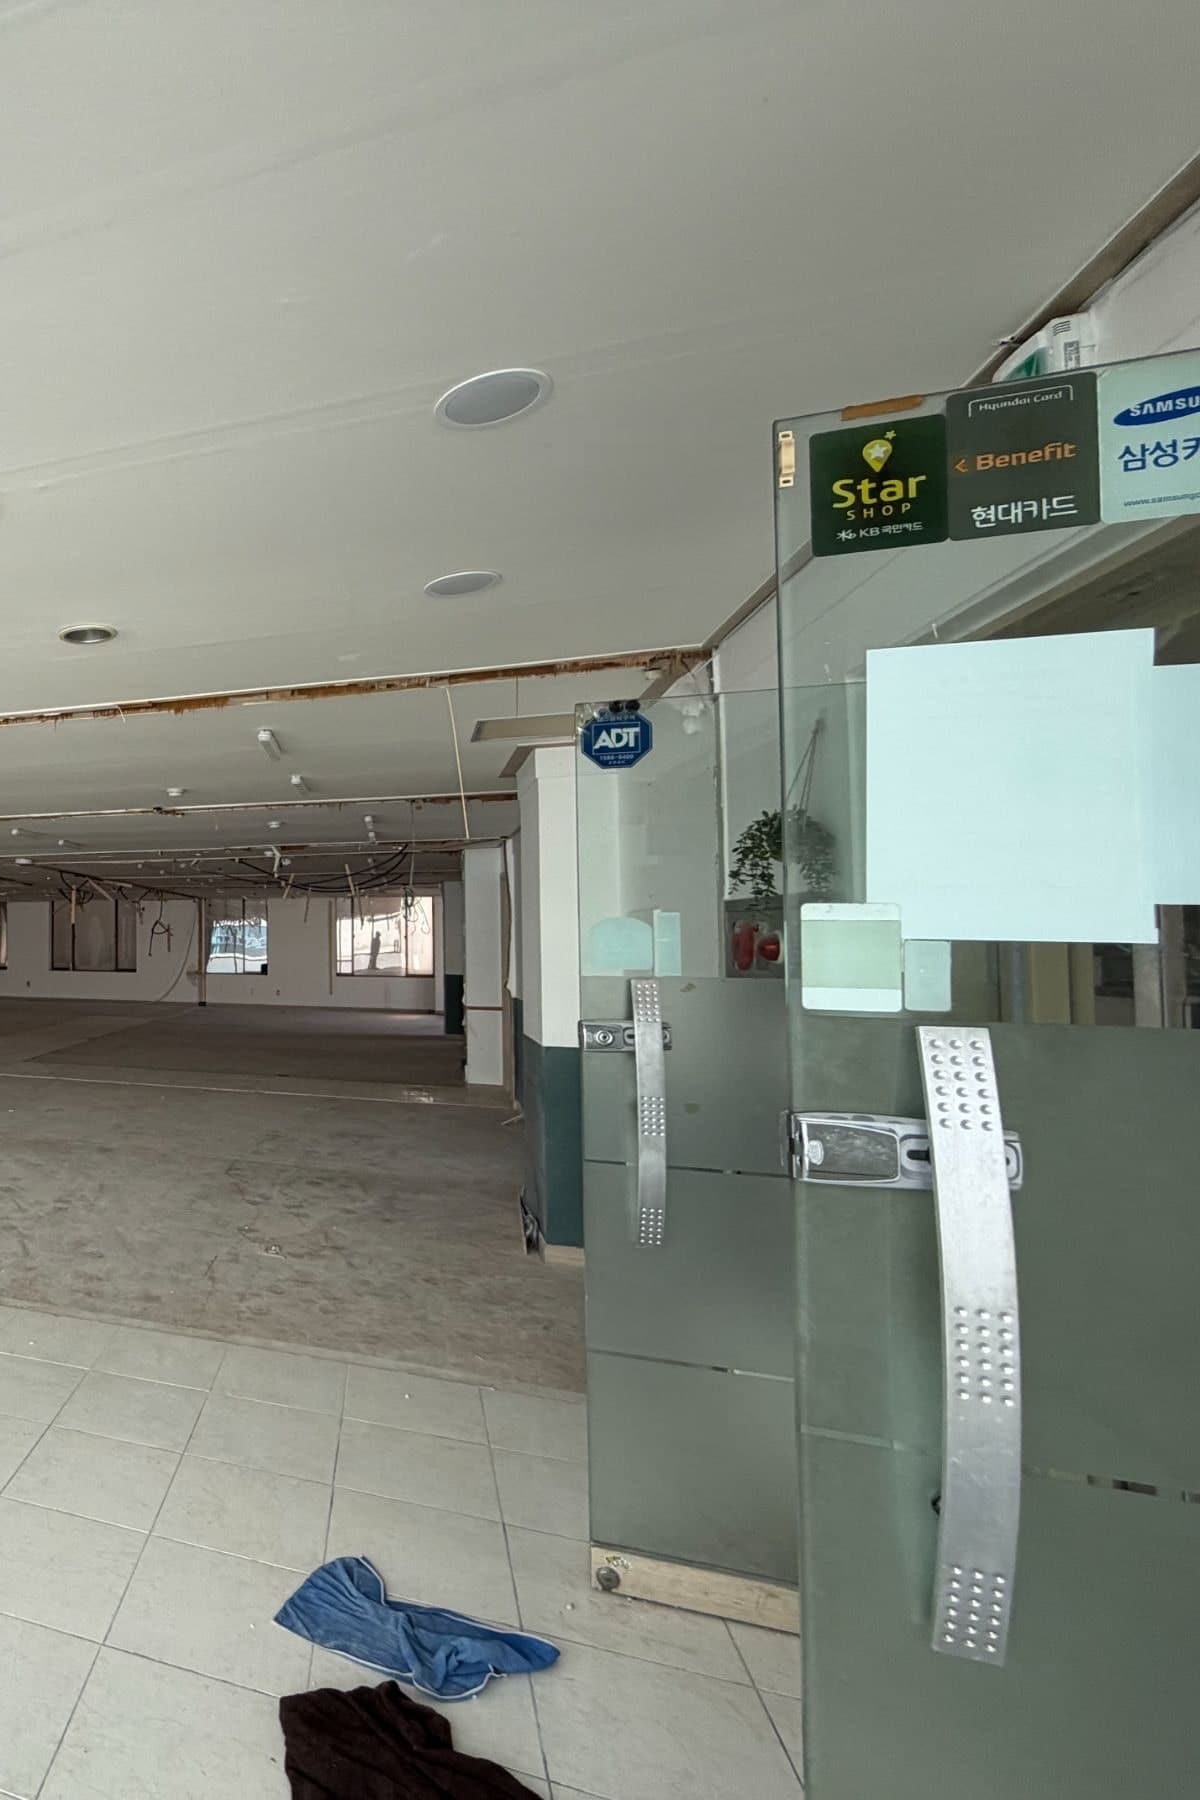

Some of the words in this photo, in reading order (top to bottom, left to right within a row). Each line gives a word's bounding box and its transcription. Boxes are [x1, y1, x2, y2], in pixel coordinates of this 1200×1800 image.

[979, 397, 1030, 411] Hyundai
[1033, 391, 1063, 403] Card
[976, 442, 1077, 471] Benefit
[832, 475, 927, 508] Star
[846, 502, 911, 520] SHOP
[970, 495, 1079, 528] 현대카드
[592, 727, 640, 749] ADT
